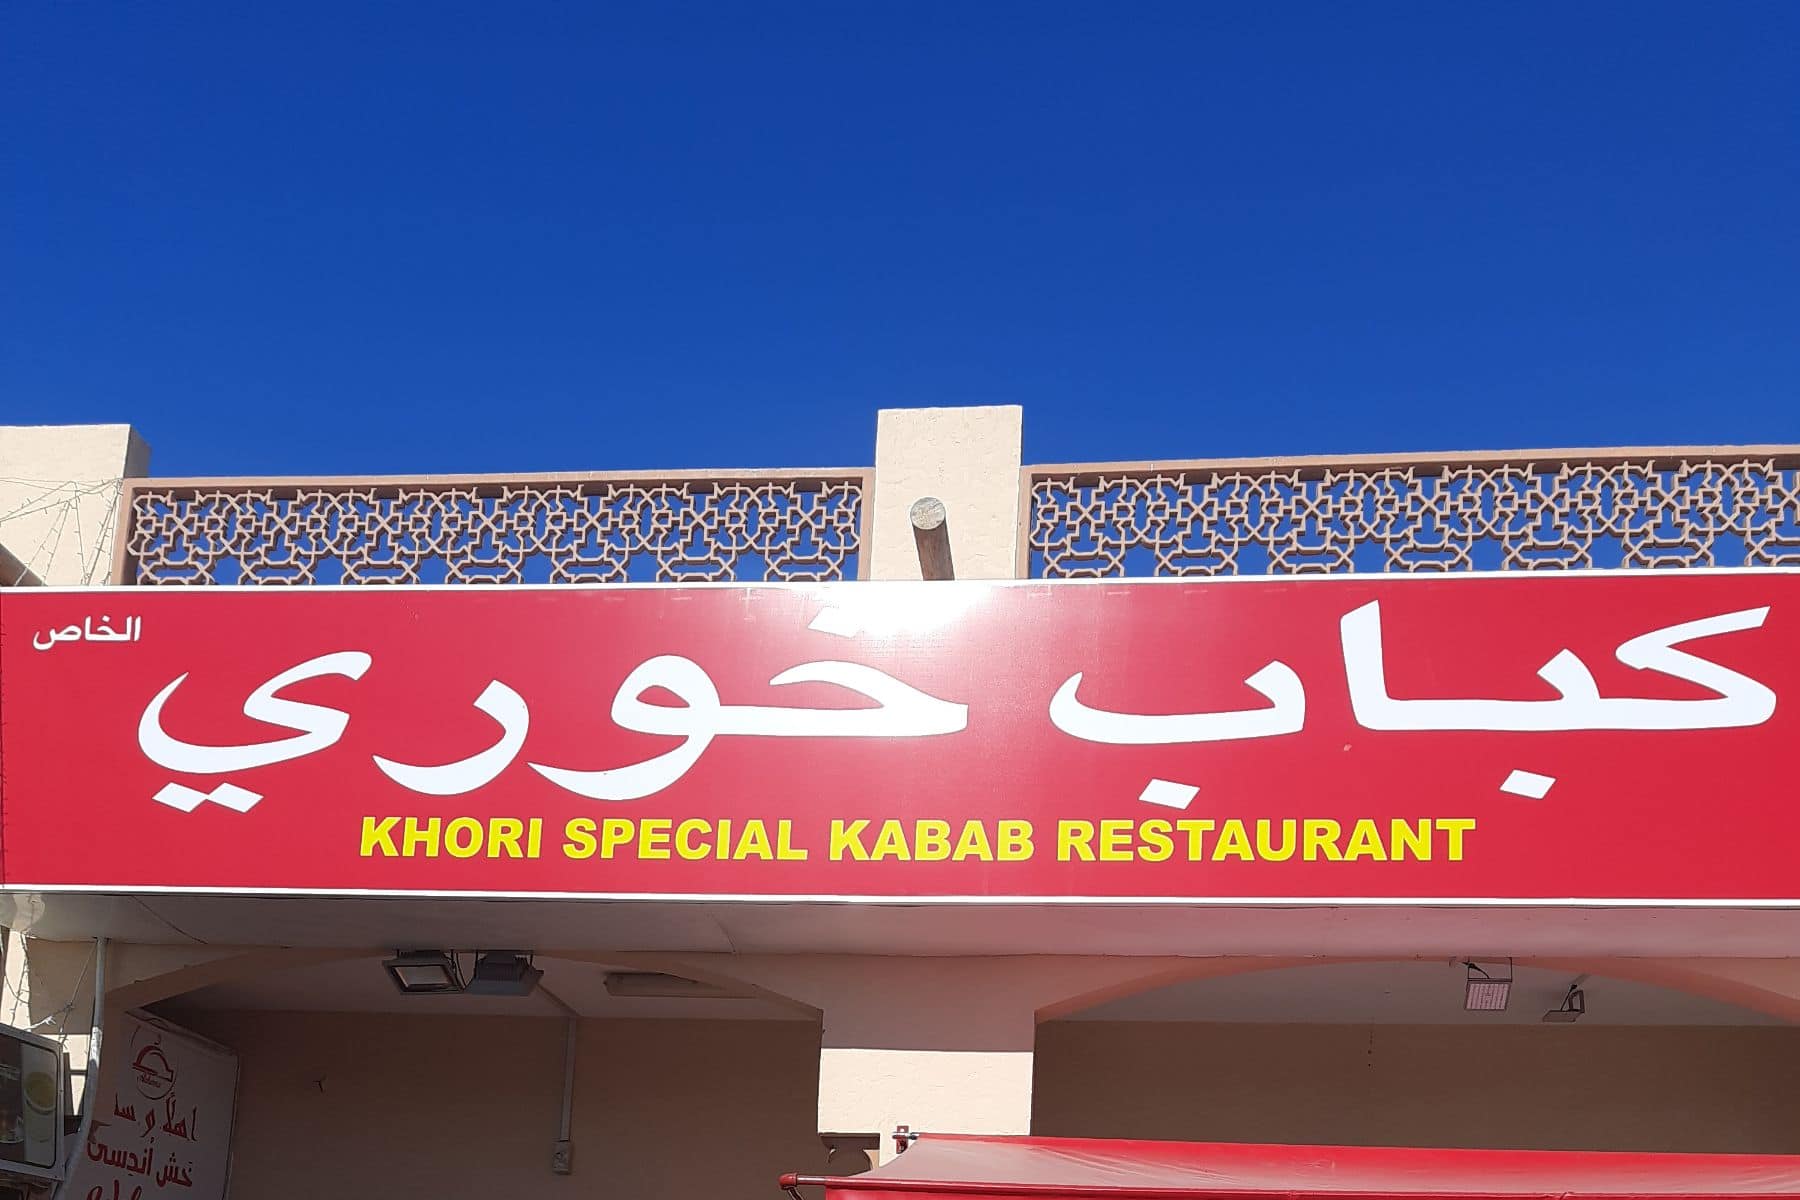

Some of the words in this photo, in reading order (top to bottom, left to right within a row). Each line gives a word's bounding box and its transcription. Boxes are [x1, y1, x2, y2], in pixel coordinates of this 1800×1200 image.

[32, 615, 142, 651] الخاص
[138, 605, 970, 813] خوري
[1049, 599, 1777, 811] كباب
[360, 816, 543, 858] KHORI
[562, 817, 807, 861] SPECIAL
[829, 821, 1033, 861] KABAB
[1057, 818, 1476, 862] RESTAURANT
